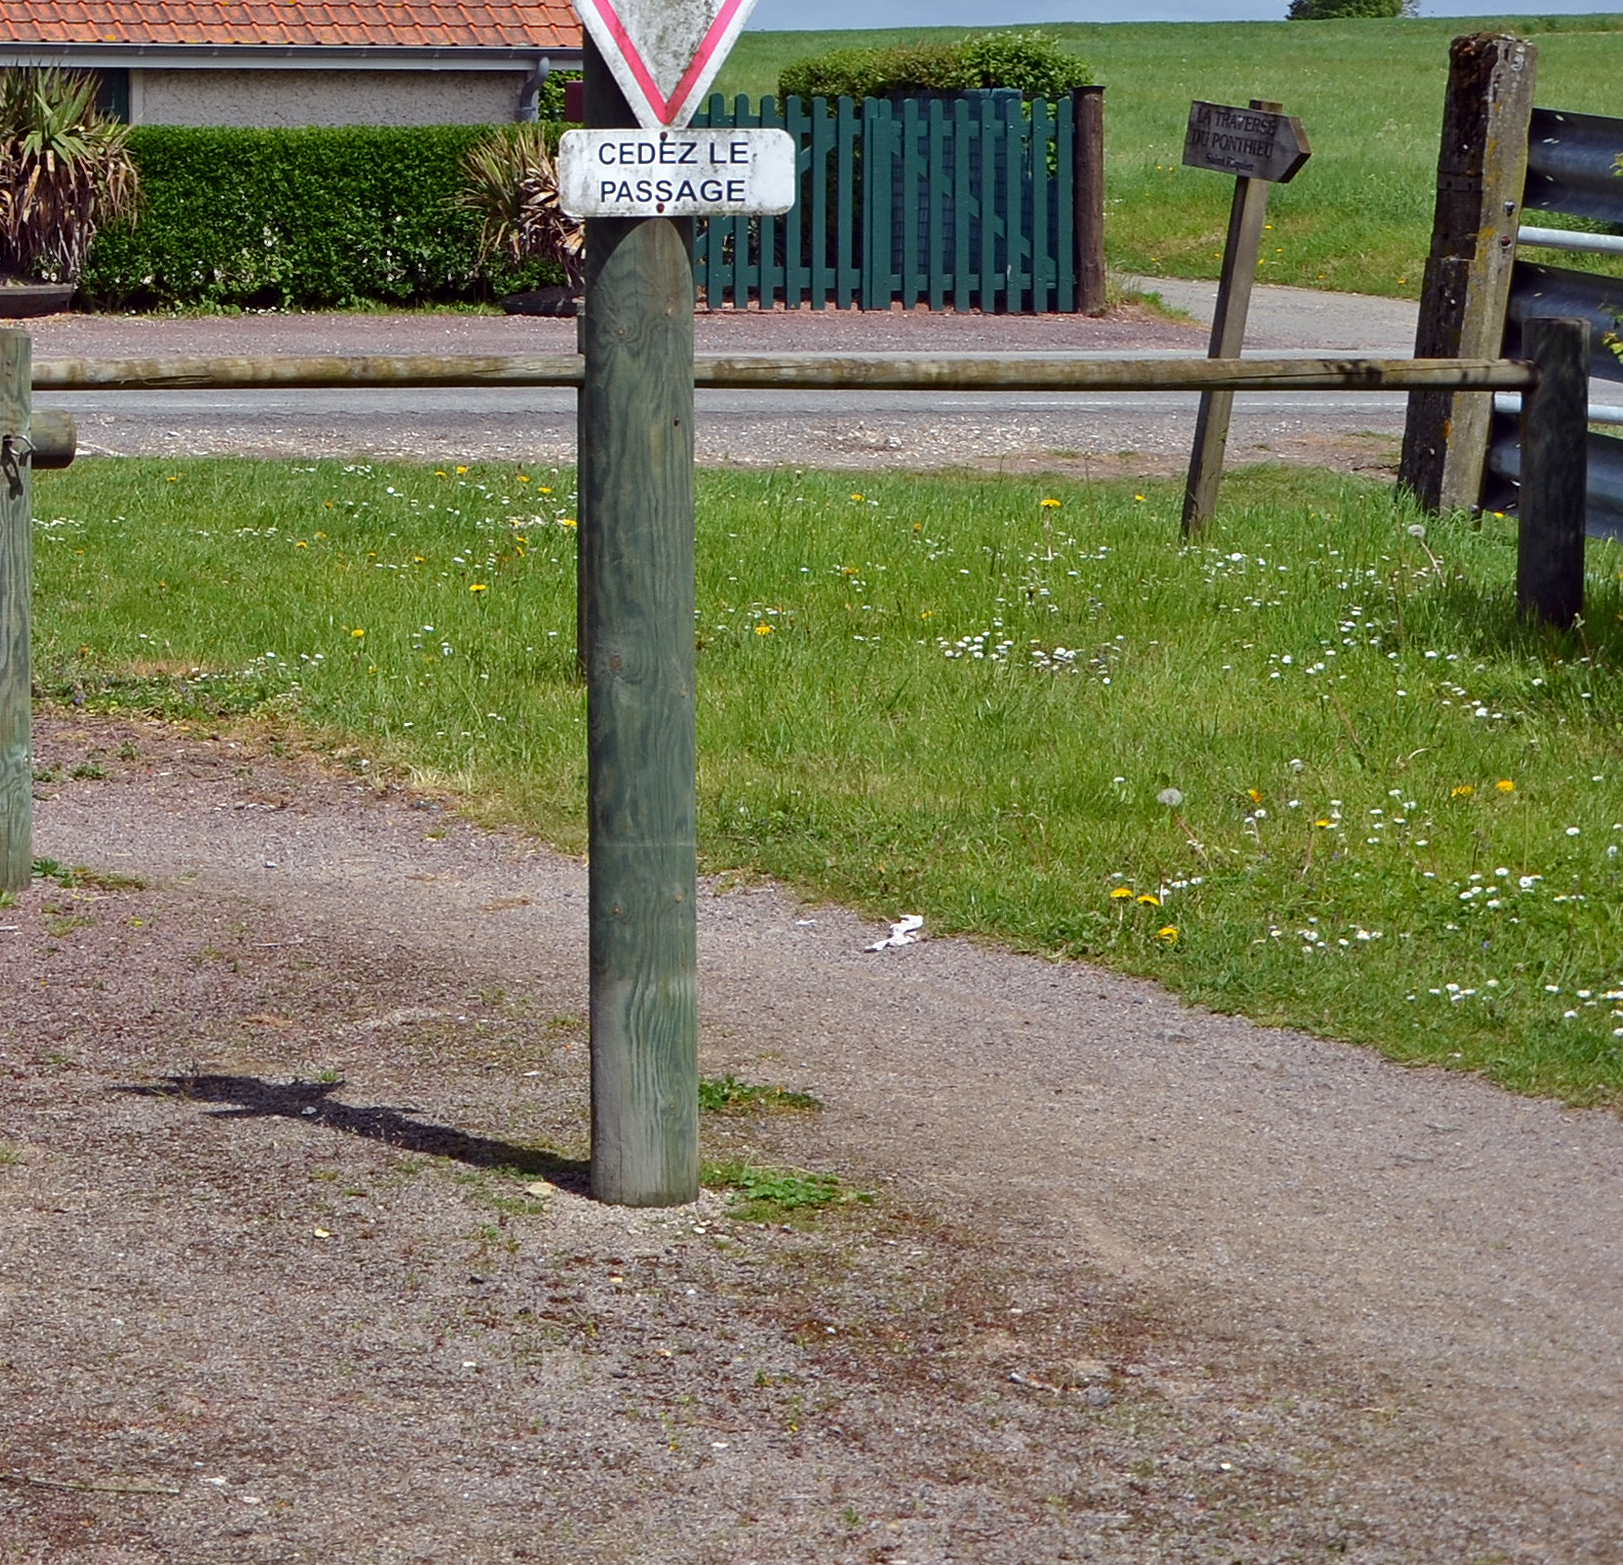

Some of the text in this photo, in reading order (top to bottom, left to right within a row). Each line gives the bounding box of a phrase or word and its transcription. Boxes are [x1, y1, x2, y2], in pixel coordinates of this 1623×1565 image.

[1197, 108, 1278, 136] LA TRAVERSE
[709, 142, 749, 164] LE
[1191, 129, 1274, 158] DU PONTHIEU
[600, 179, 745, 203] PASSAGE
